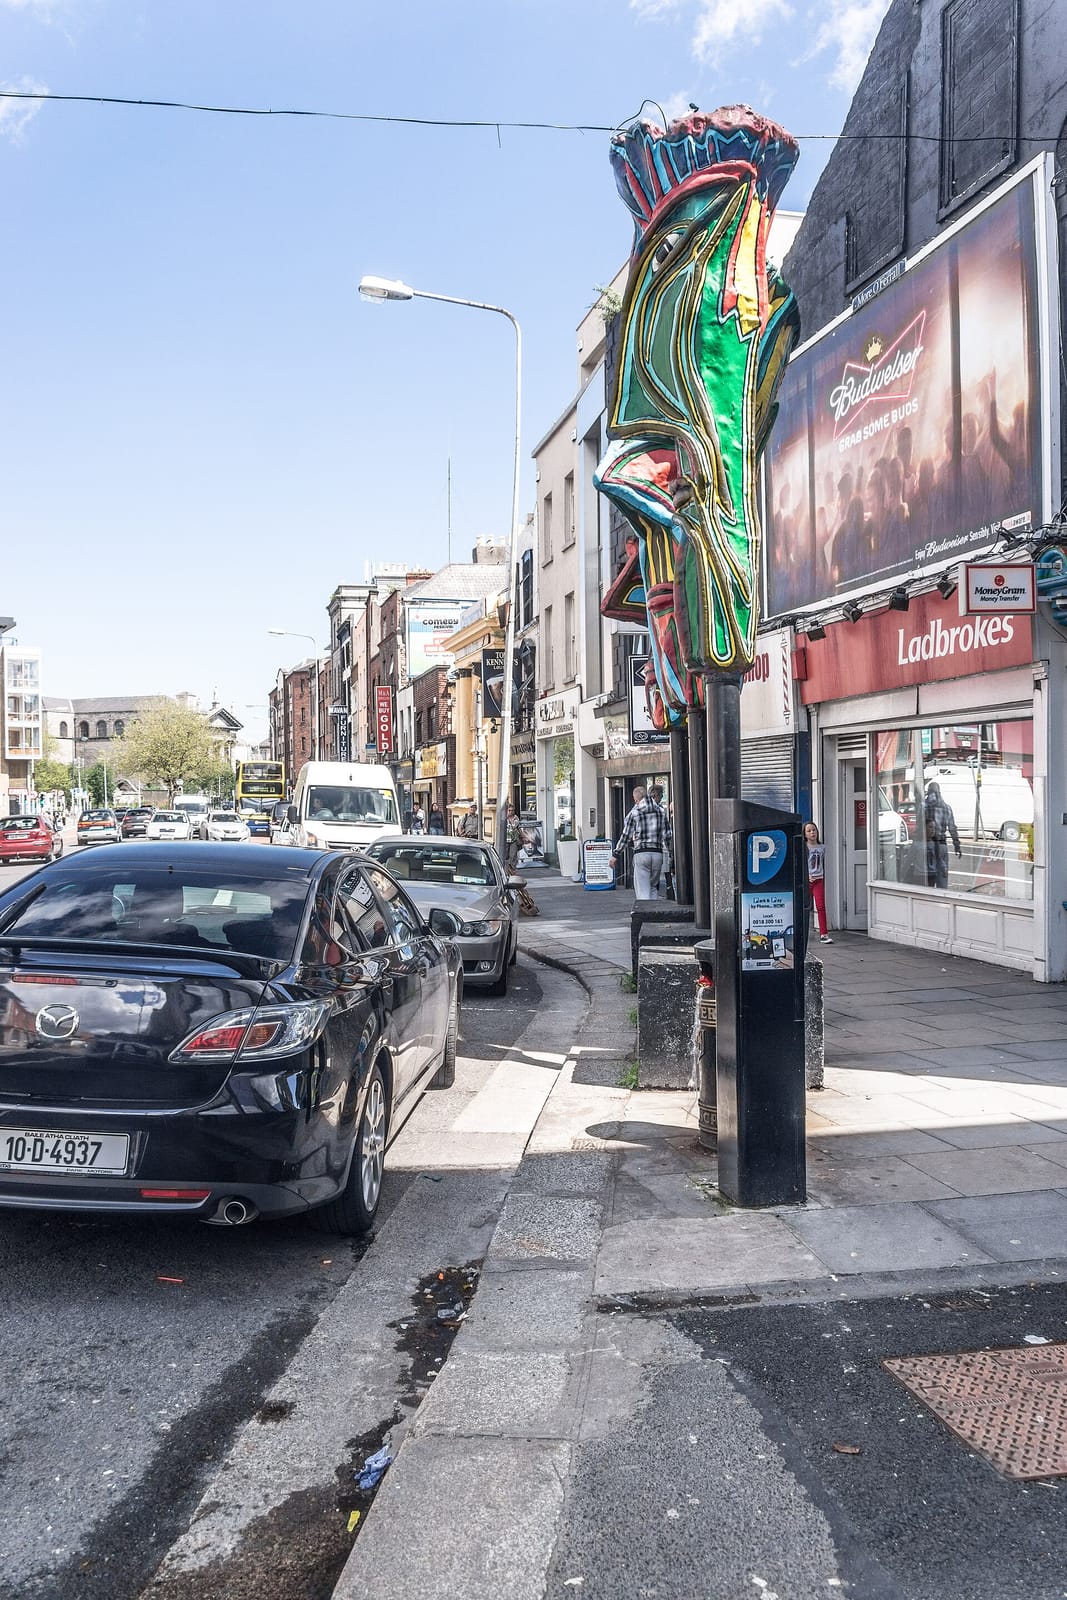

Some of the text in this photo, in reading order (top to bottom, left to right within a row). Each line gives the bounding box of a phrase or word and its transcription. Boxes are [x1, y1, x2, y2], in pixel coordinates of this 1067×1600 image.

[857, 287, 873, 306] More
[830, 346, 924, 421] Budweiser
[839, 398, 919, 453] GRAB SOME BUDS
[925, 534, 969, 558] Budweiser
[974, 586, 1025, 597] MoneyGram
[980, 595, 998, 603] Money
[898, 614, 1015, 666] Ladbrokes
[340, 714, 348, 762] FURNITURE
[380, 714, 390, 750] GOLD
[752, 835, 775, 873] P
